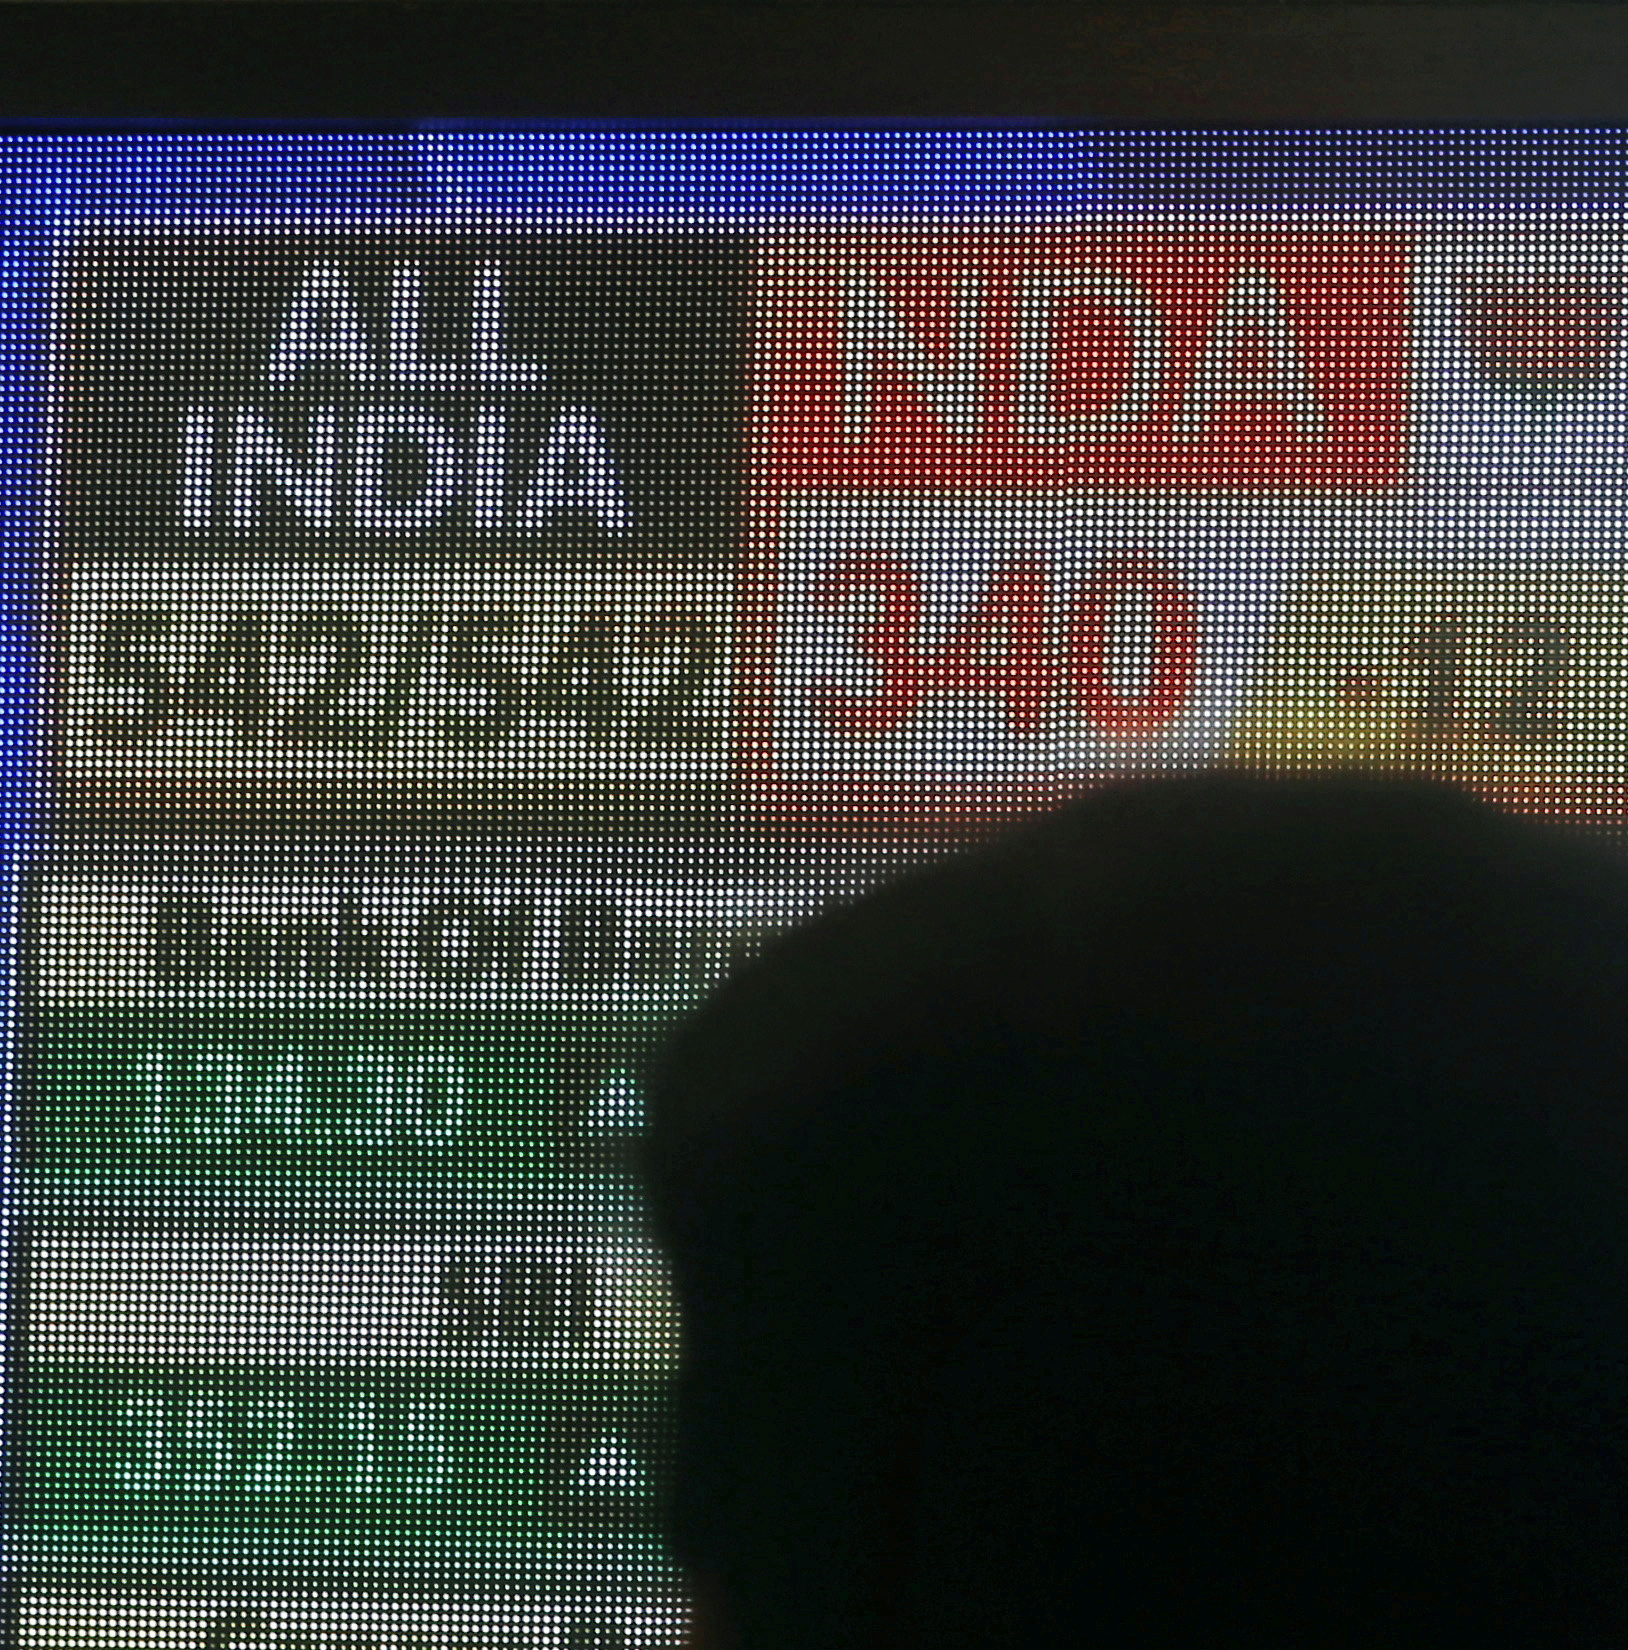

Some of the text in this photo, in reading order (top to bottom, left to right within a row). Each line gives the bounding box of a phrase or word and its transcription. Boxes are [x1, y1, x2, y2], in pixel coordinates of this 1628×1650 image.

[265, 259, 545, 388] ALL
[836, 260, 1330, 449] NDA
[178, 406, 631, 534] INDIA
[87, 605, 721, 753] 542/542
[807, 549, 1199, 738] 340
[1336, 611, 1572, 744] -12
[154, 893, 765, 987] Bank Of Bar
[128, 1043, 469, 1151] 134.30
[438, 1252, 594, 1351] SBI
[112, 1389, 455, 1498] 352.15
